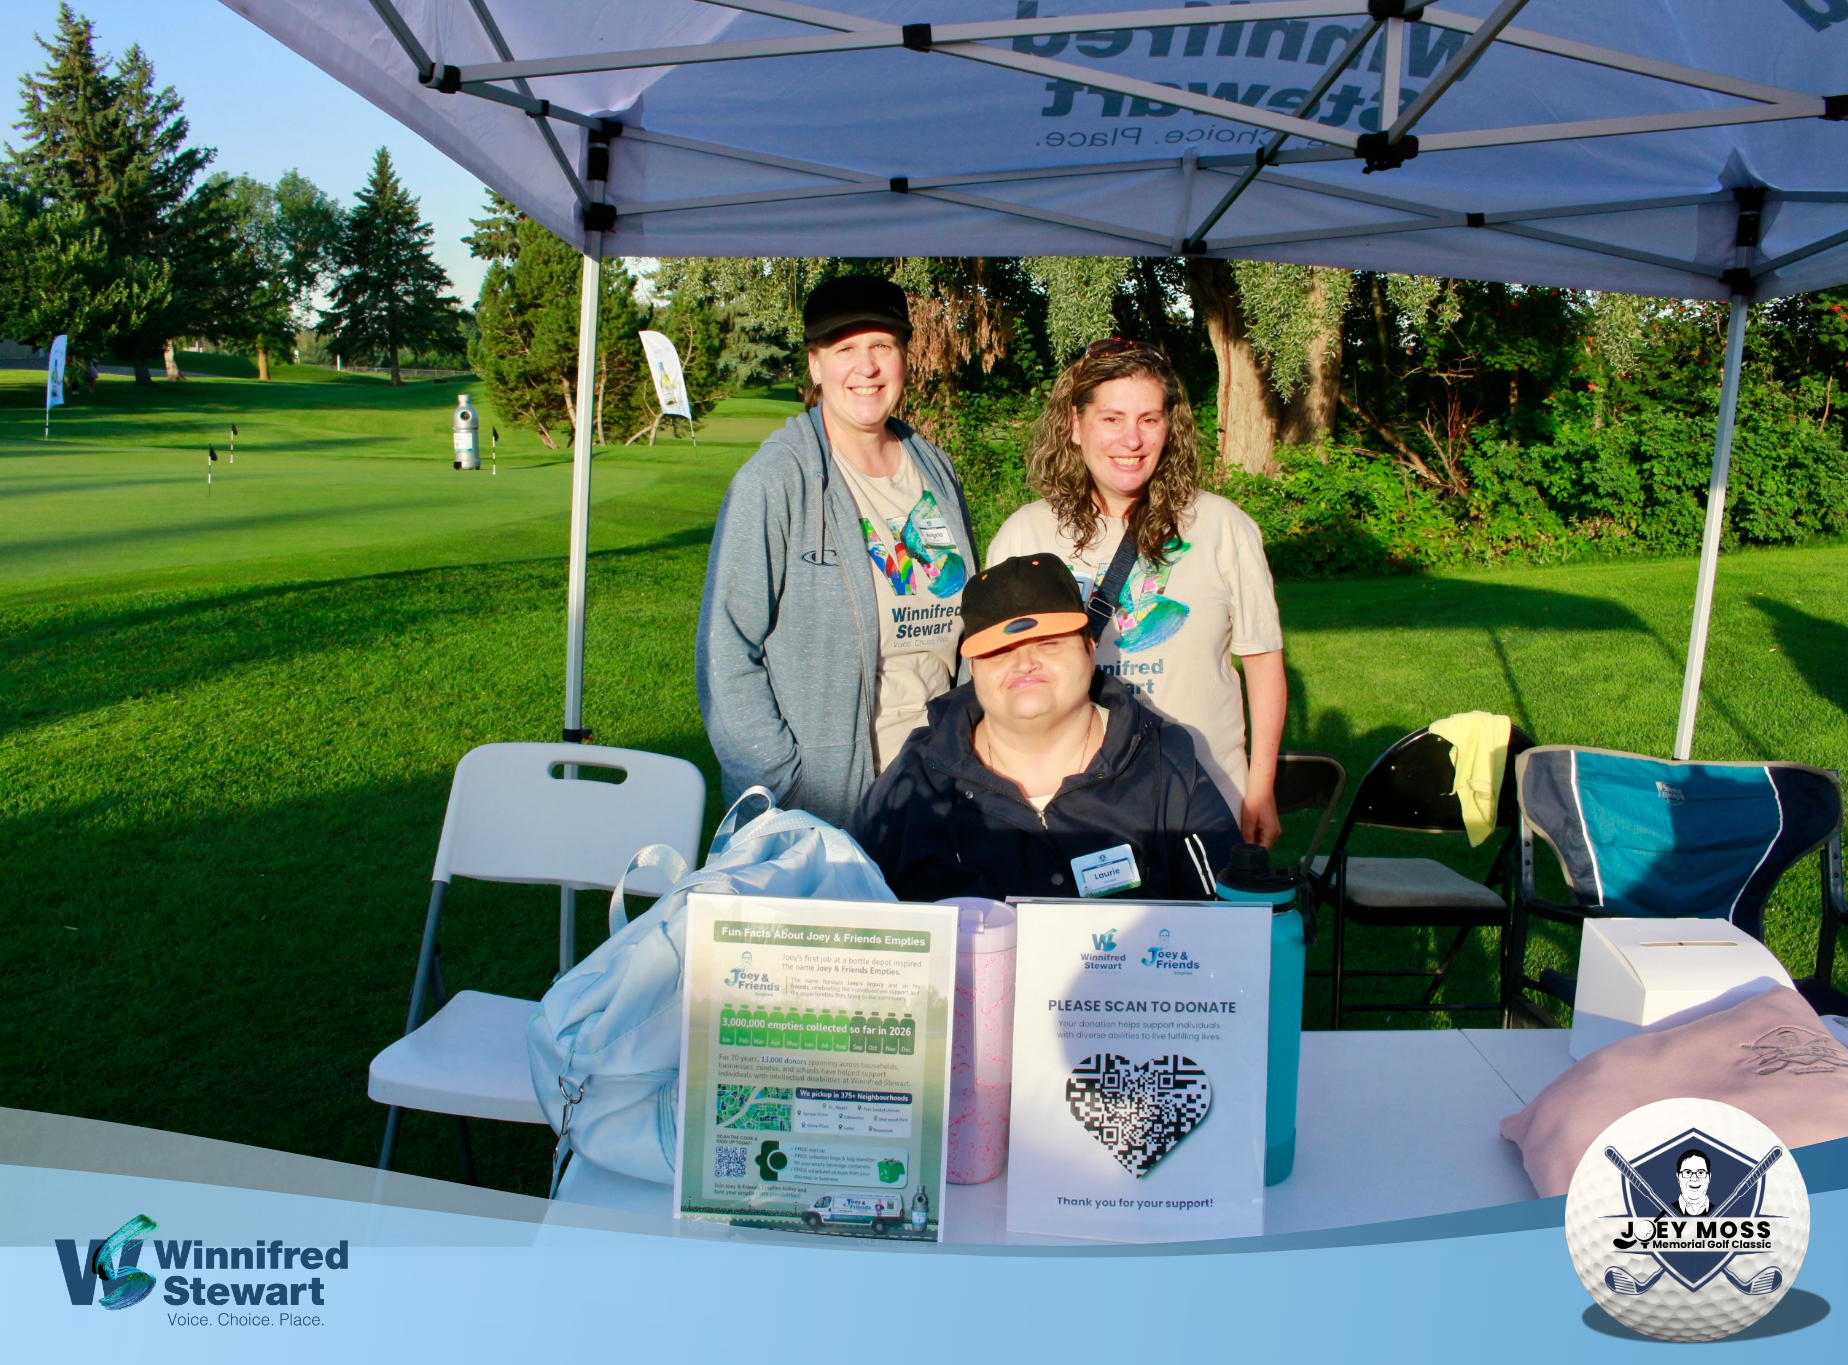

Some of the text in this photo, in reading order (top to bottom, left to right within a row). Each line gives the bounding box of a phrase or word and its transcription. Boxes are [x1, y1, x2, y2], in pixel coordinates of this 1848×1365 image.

[896, 620, 953, 639] Stewart
[1094, 868, 1120, 880] Laurie
[722, 927, 740, 936] Fun
[745, 928, 771, 938] Facts
[774, 929, 804, 939] About
[806, 932, 830, 944] Joey
[844, 934, 881, 944] Friends
[885, 936, 925, 949] Empties
[783, 953, 802, 962] Joey's
[821, 955, 831, 964] job
[849, 957, 870, 965] bottle
[872, 959, 892, 968] depot
[894, 959, 922, 969] inspired
[1081, 953, 1126, 961] Winnifred
[1141, 947, 1188, 966] Joey &
[817, 965, 832, 973] Joey
[842, 966, 868, 974] Friends
[870, 967, 902, 977] Empties.
[1084, 962, 1122, 970] Stewart
[1156, 960, 1200, 969] Friends
[724, 967, 769, 988] Joey &
[738, 980, 780, 991] Friends
[1049, 1000, 1236, 1013] PLEASE SCAN TO DONATE
[723, 1017, 765, 1029] 3,000,000
[768, 1020, 803, 1032] empties
[806, 1022, 847, 1033] collected
[863, 1025, 875, 1034] far
[879, 1026, 887, 1035] in
[890, 1026, 912, 1036] 2026
[1058, 1020, 1077, 1028] Your
[1142, 1021, 1174, 1029] support
[1177, 1021, 1220, 1029] individuals
[1076, 1031, 1106, 1039] diverse
[1168, 1032, 1199, 1041] fulfilling
[761, 1056, 783, 1064] 13,000
[784, 1057, 807, 1065] donors
[809, 1060, 837, 1068] spanning
[861, 1062, 899, 1070] households,
[718, 1070, 752, 1078] individuals
[770, 1073, 804, 1081] intellectual
[807, 1075, 840, 1083] disabilities
[851, 1077, 883, 1085] Winnifred
[756, 1064, 781, 1072] condos,
[796, 1066, 819, 1074] schools
[838, 1069, 859, 1077] helped
[861, 1071, 886, 1079] support
[812, 1090, 832, 1099] pickup
[841, 1092, 856, 1100] 375+
[857, 1093, 908, 1103] Neighbourhoods
[1057, 1197, 1213, 1210] Thank you for your support!
